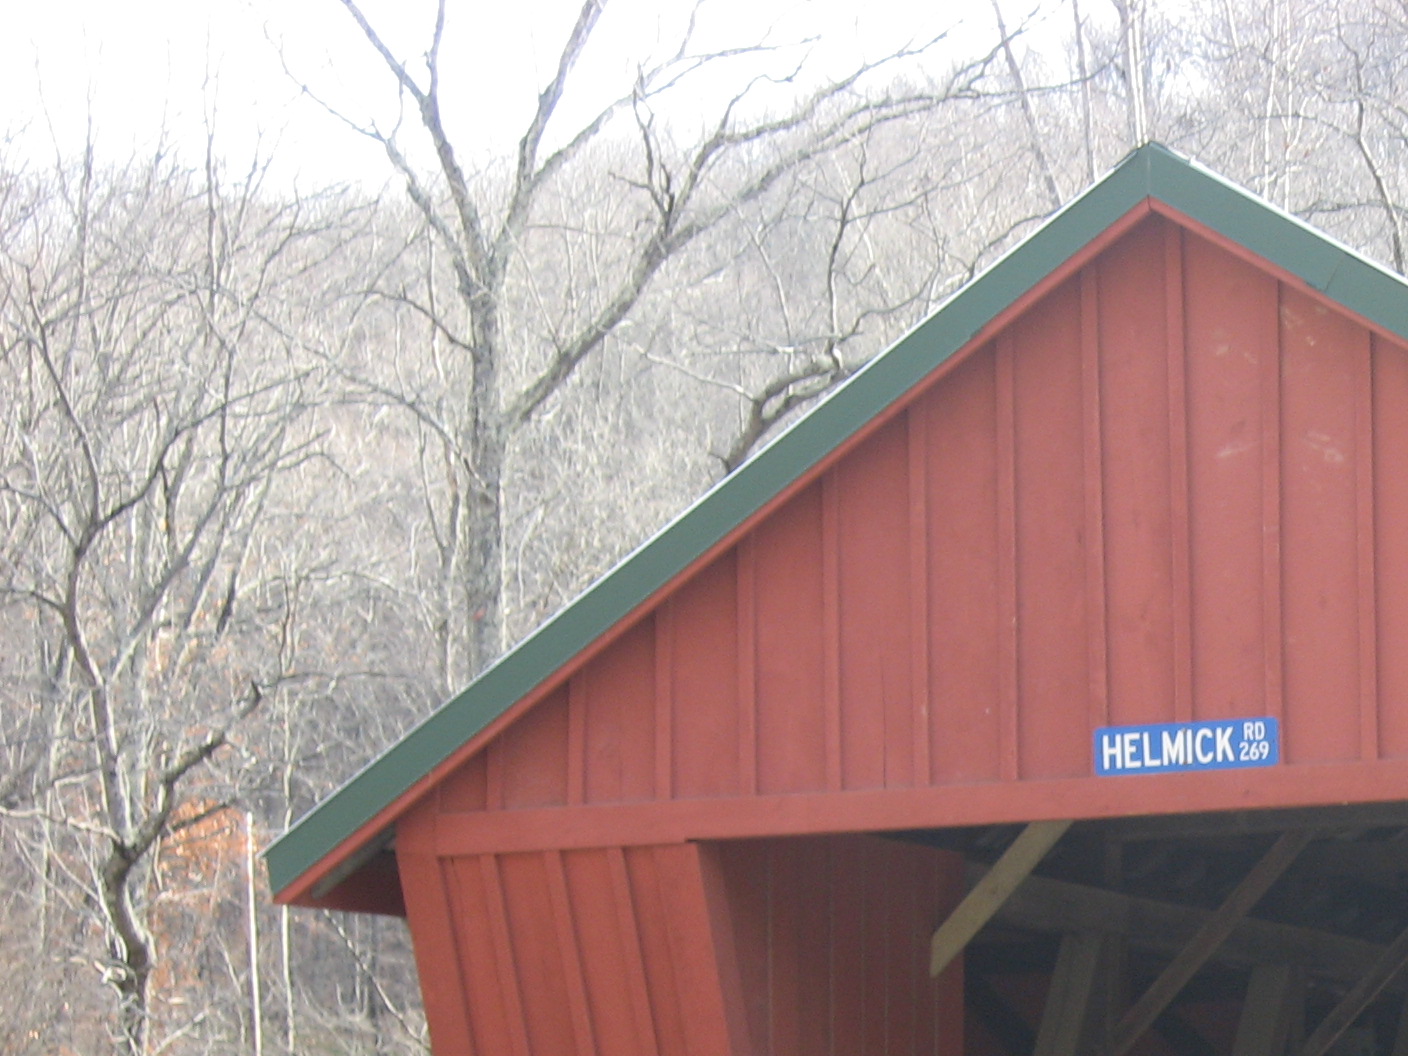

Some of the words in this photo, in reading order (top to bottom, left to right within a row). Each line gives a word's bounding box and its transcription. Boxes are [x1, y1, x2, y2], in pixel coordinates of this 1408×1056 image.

[1243, 721, 1266, 741] RD
[1102, 726, 1235, 770] HELMICK
[1239, 741, 1270, 762] 269
